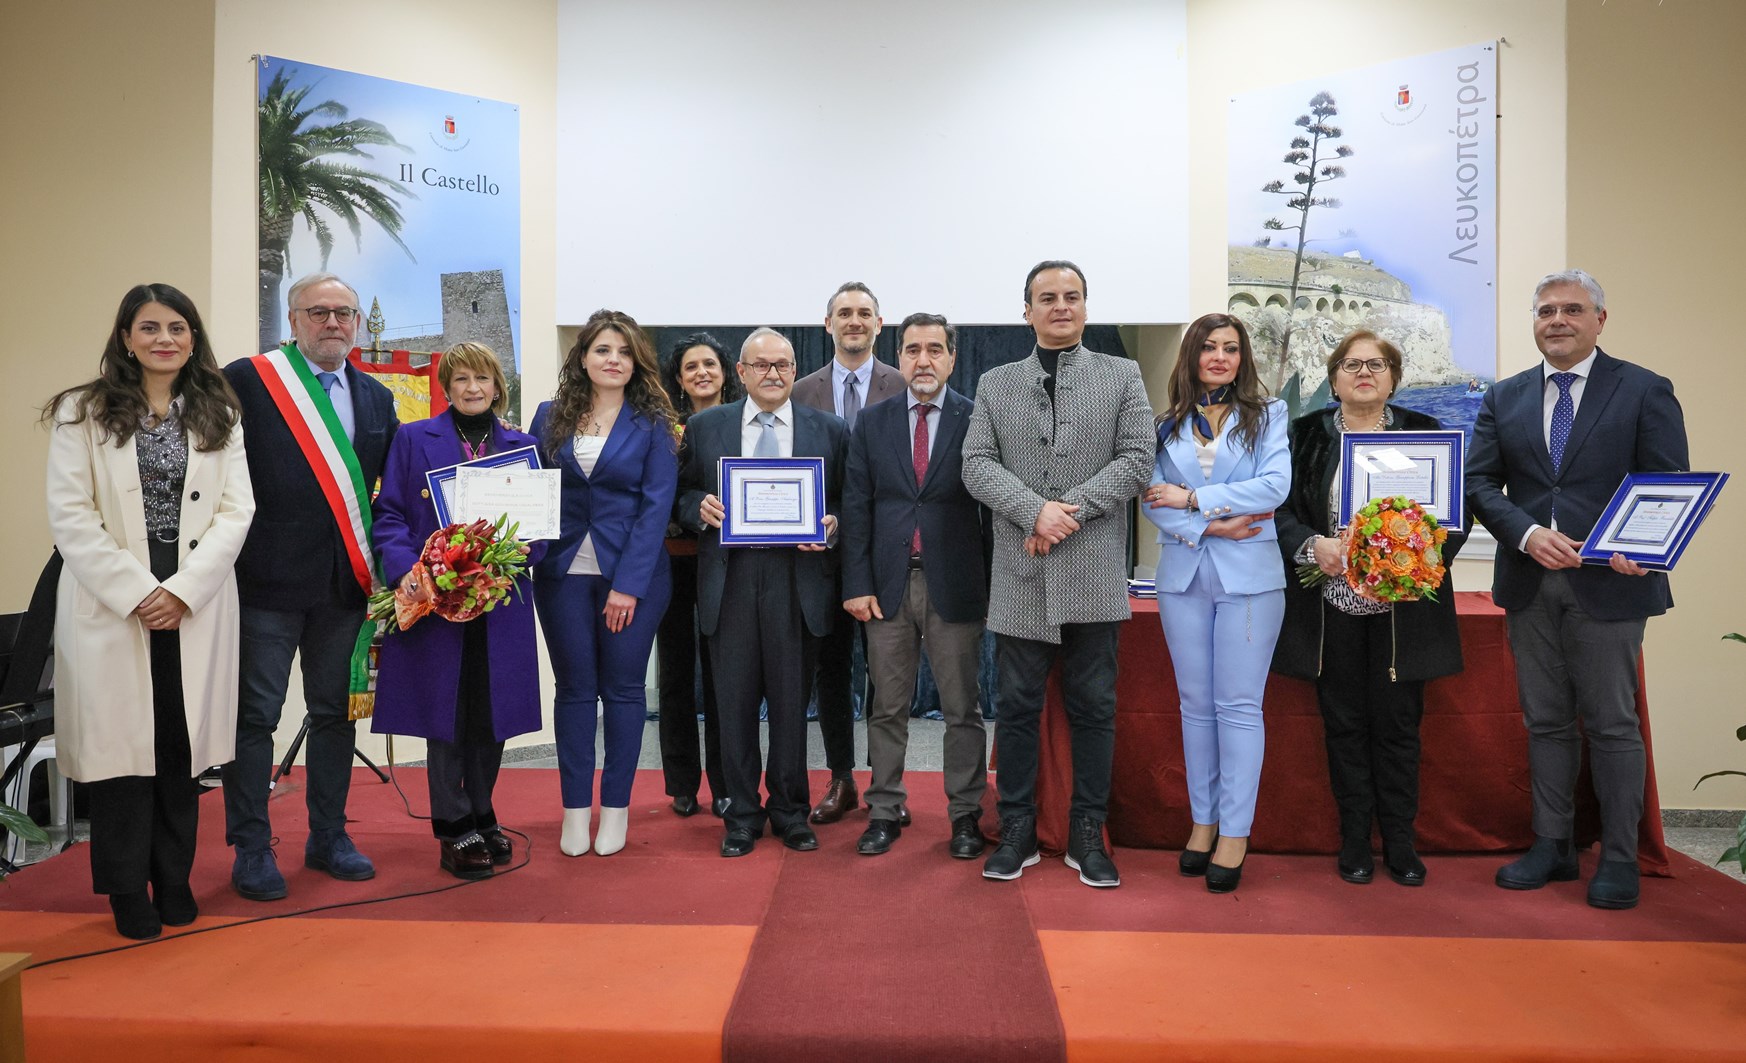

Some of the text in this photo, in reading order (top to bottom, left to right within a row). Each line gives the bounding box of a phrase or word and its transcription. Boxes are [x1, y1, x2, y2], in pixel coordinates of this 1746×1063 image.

[399, 163, 500, 196] Il Castello
[1448, 61, 1487, 265] Λευκοπέτρα
